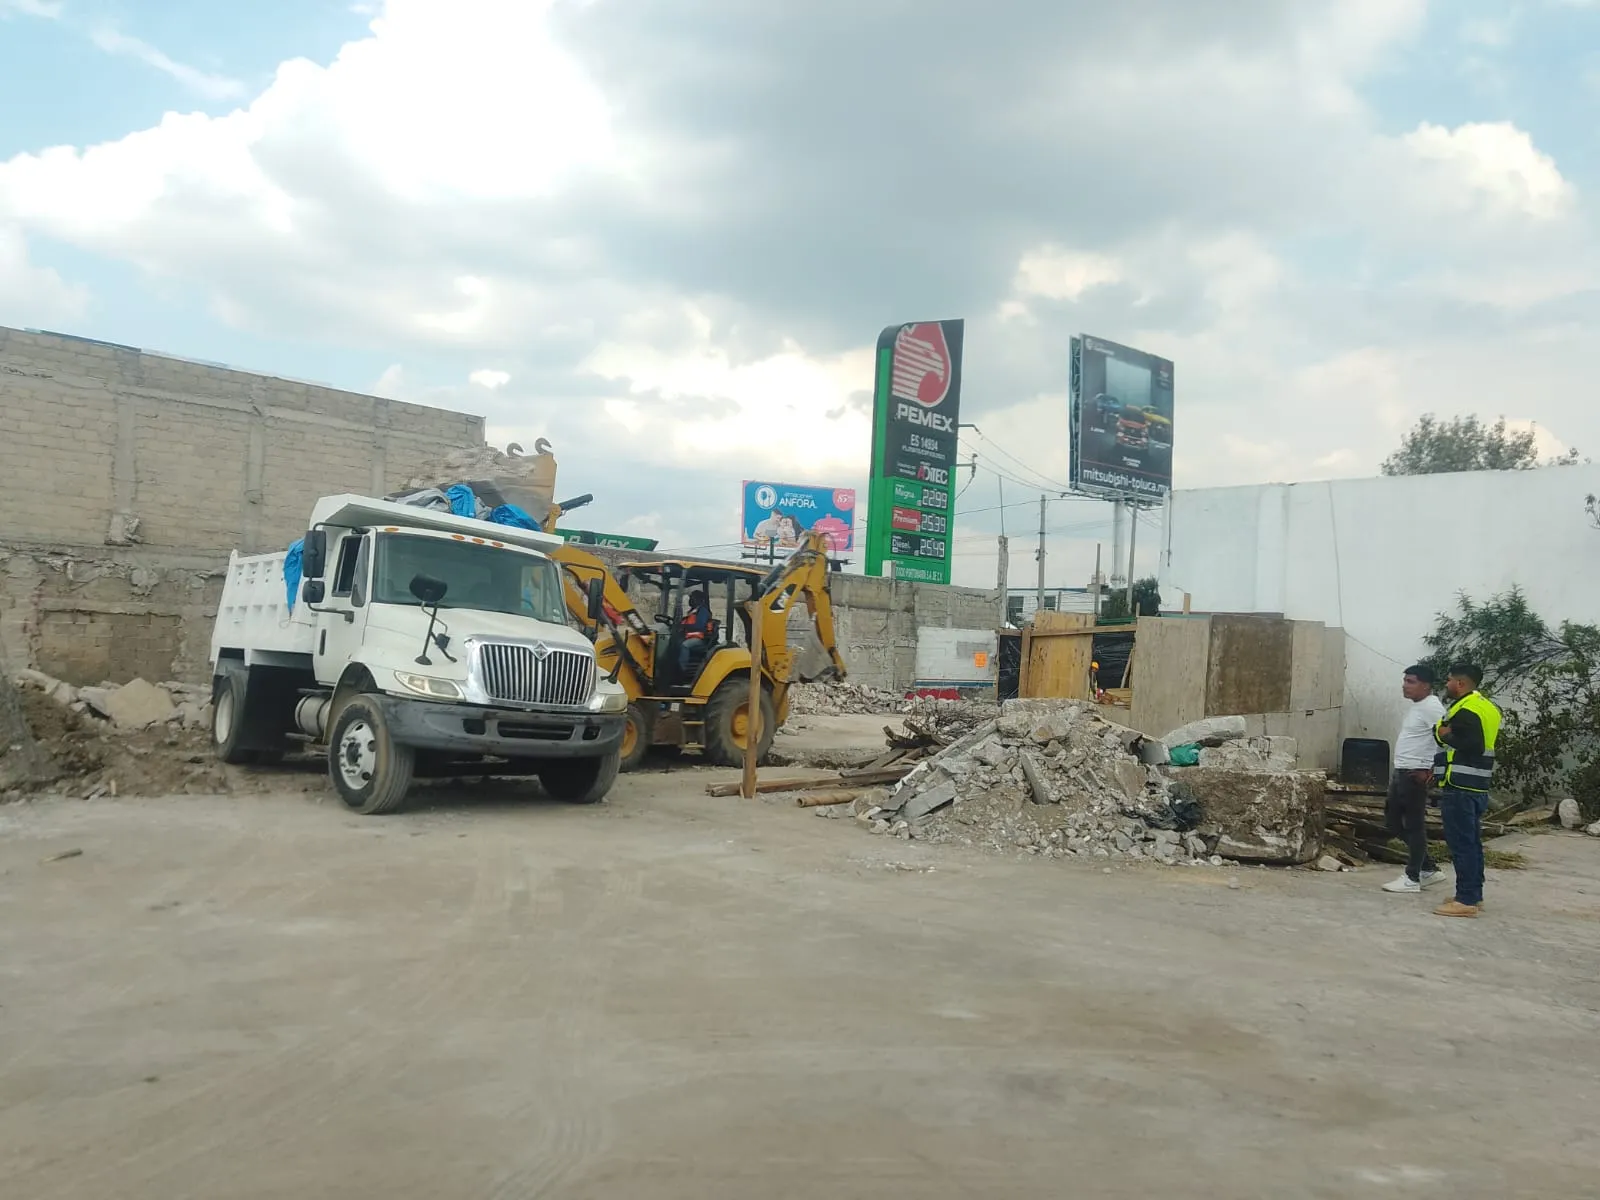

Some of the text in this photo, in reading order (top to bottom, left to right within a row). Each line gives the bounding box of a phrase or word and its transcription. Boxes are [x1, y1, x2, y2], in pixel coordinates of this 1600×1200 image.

[897, 403, 953, 432] PEMEX
[910, 434, 920, 447] ES
[779, 497, 816, 509] ANFORA
